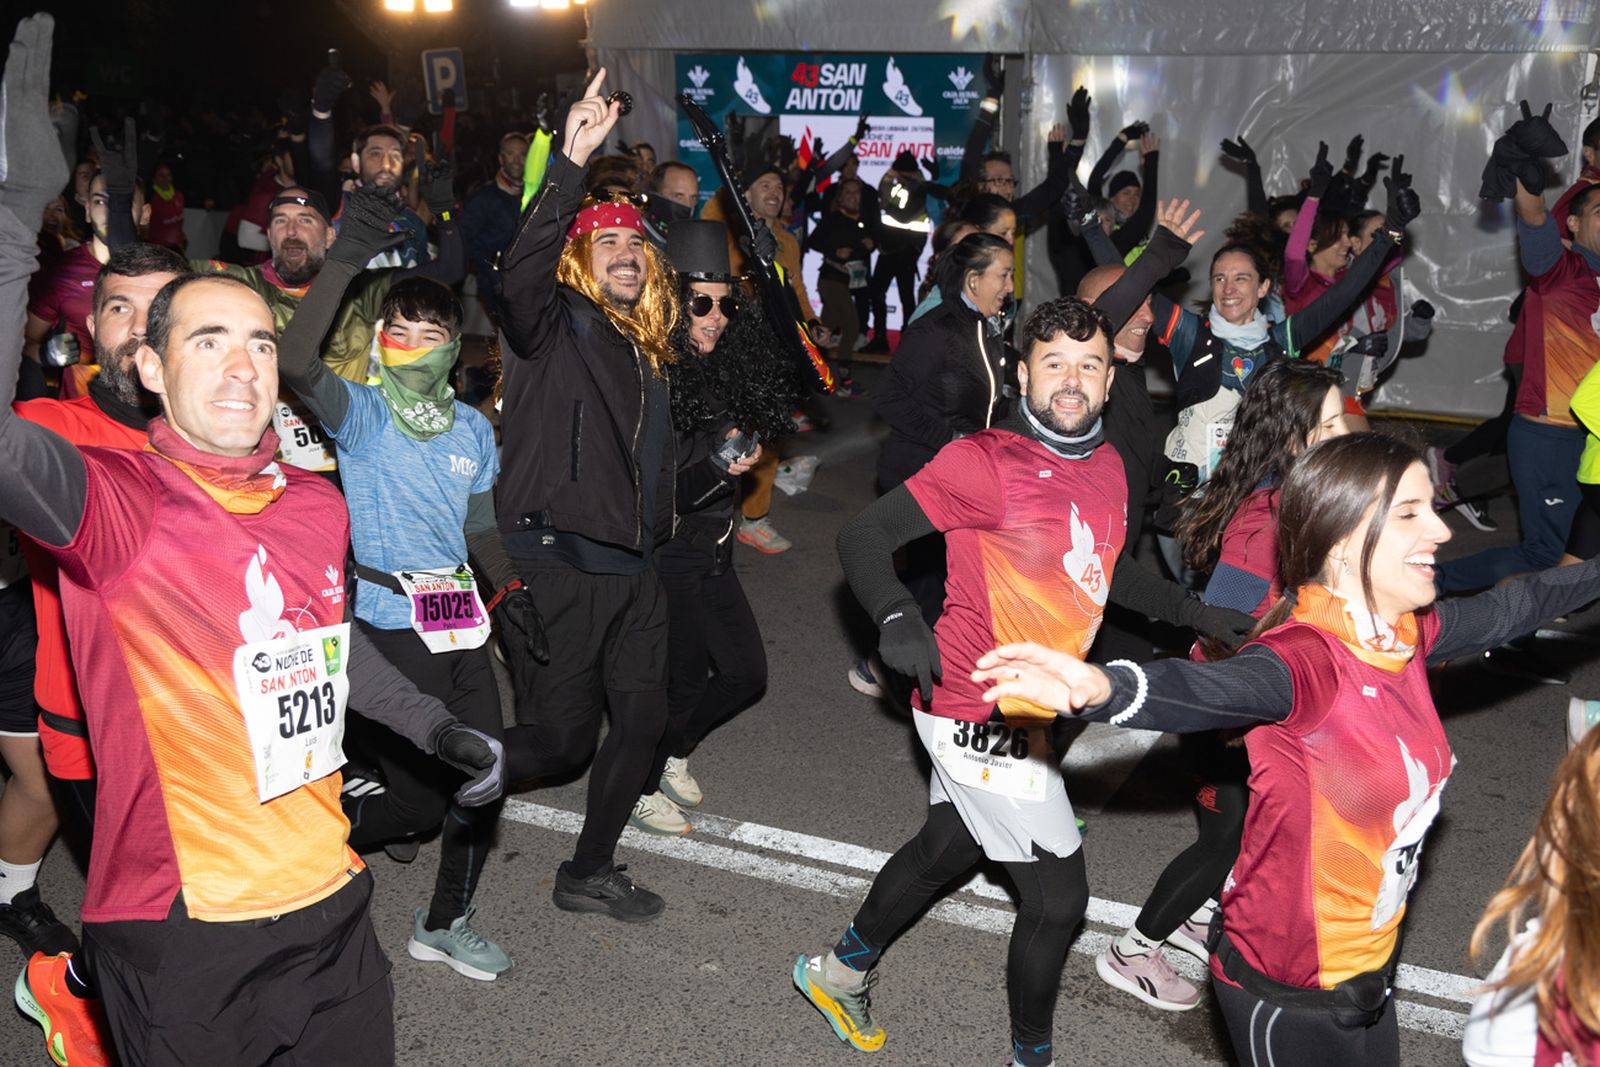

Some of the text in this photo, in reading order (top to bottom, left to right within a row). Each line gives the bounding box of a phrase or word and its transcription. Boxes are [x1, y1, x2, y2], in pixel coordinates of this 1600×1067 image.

[433, 57, 456, 92] P
[791, 62, 867, 88] 43 SAN
[784, 82, 863, 111] ANTÓN
[857, 142, 892, 159] SAN
[415, 583, 431, 592] SAN
[1081, 563, 1102, 593] 43
[419, 592, 474, 621] 15025
[301, 648, 314, 664] DE
[261, 675, 286, 694] SAN
[288, 665, 317, 689] NTÓN
[278, 681, 336, 739] 5213
[953, 719, 1029, 760] 3826
